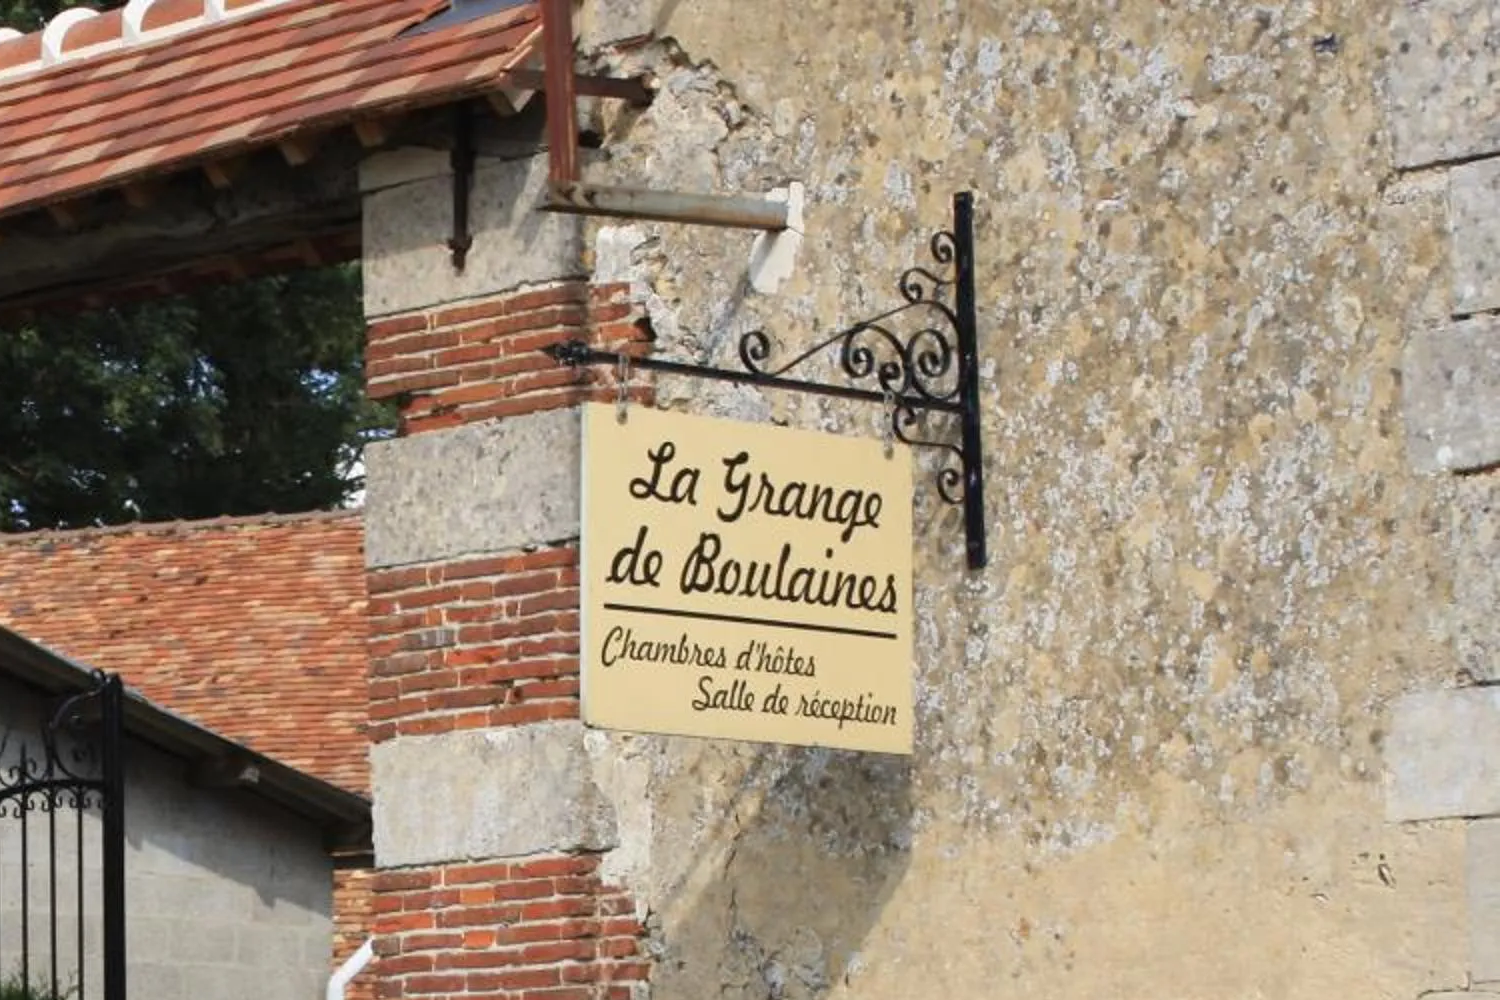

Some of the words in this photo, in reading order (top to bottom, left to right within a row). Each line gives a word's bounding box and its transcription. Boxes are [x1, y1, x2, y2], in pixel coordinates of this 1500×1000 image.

[629, 441, 701, 506] La
[717, 451, 883, 543] Grange
[605, 525, 663, 587] de
[680, 531, 898, 614] Boulaines
[601, 625, 727, 669] Chambres
[734, 639, 816, 678] d'hôtes
[692, 675, 754, 712] Salle
[761, 683, 789, 714] de
[797, 690, 898, 730] réception
